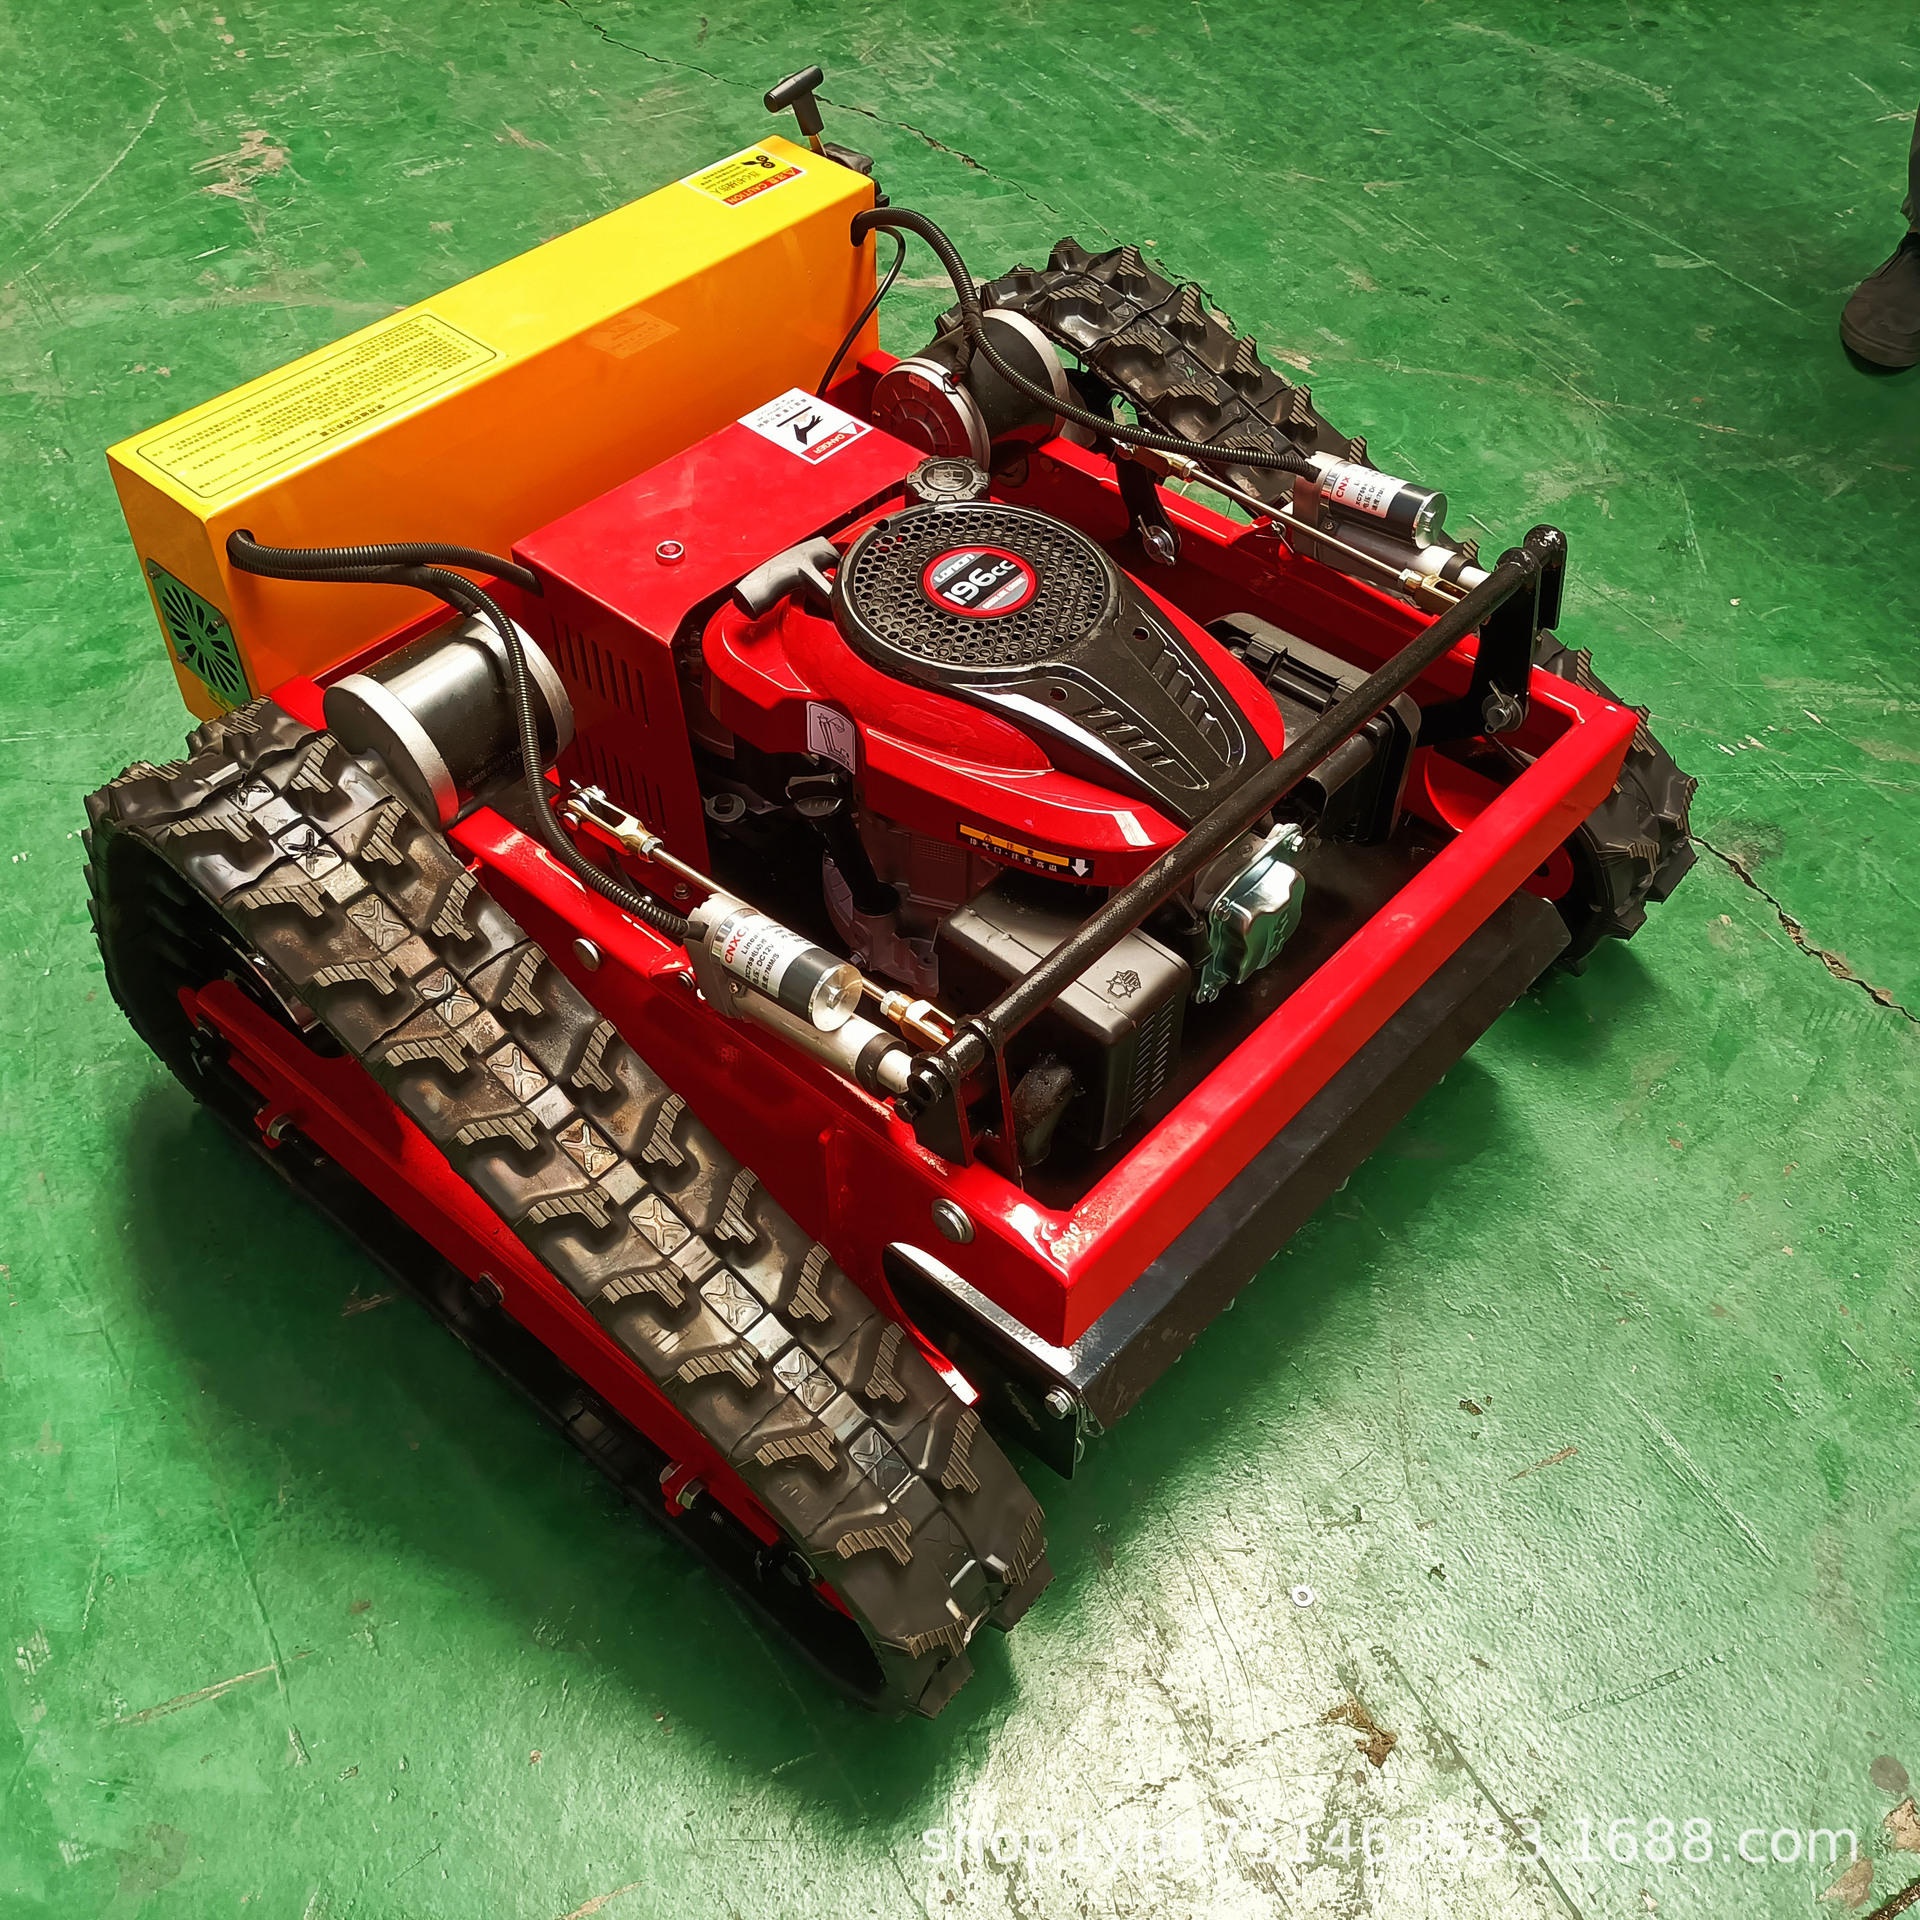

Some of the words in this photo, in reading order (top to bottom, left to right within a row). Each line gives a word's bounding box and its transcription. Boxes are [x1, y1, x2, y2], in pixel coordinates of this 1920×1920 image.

[727, 183, 768, 204] CAUTION
[813, 434, 846, 455] DANGER
[942, 560, 1017, 606] 196cc
